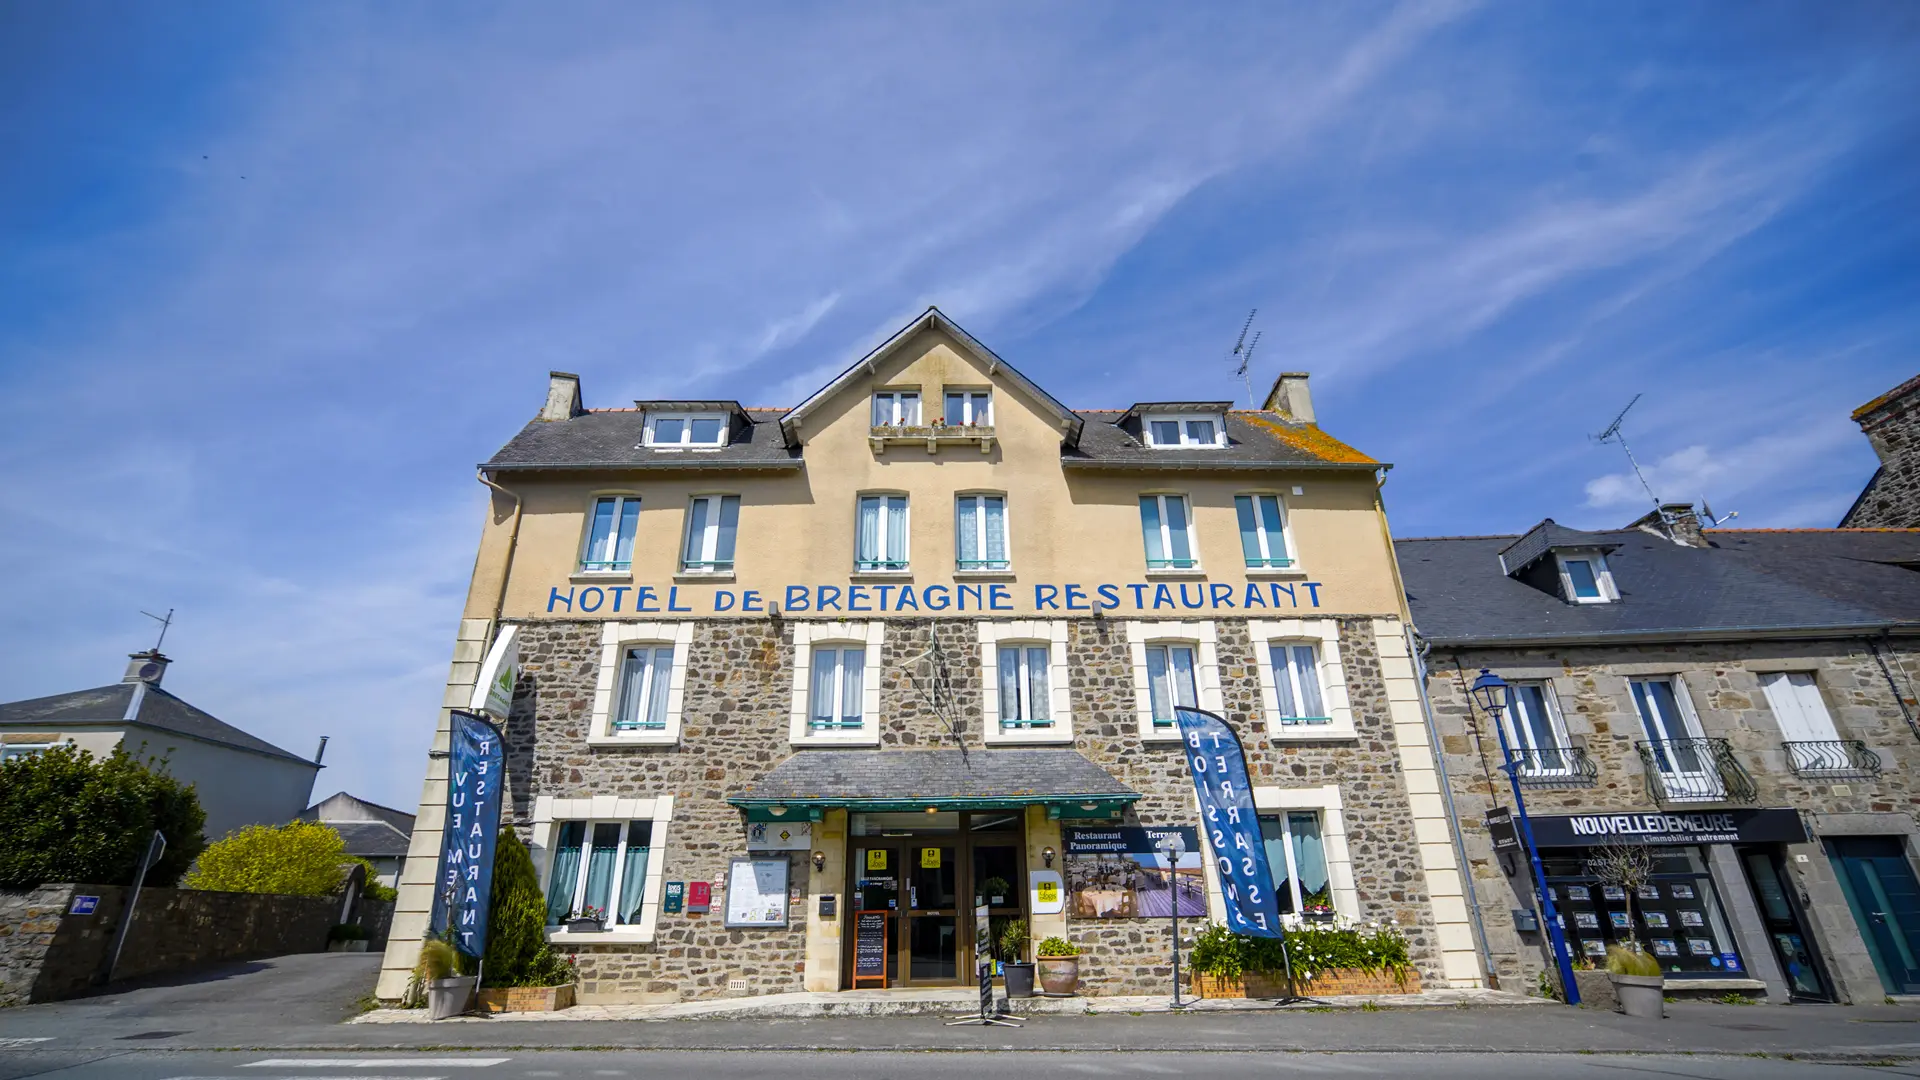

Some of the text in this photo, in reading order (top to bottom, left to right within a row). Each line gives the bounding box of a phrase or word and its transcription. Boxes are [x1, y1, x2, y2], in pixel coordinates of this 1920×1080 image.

[547, 582, 1322, 613] HOTEL DE BRETAGNE RESTAURANT
[1570, 814, 1737, 835] NOUVELLEDEMEURE
[1074, 831, 1121, 840] Restaurant
[1643, 833, 1739, 843] L'immobilier autrement
[1070, 842, 1127, 852] Panoramique
